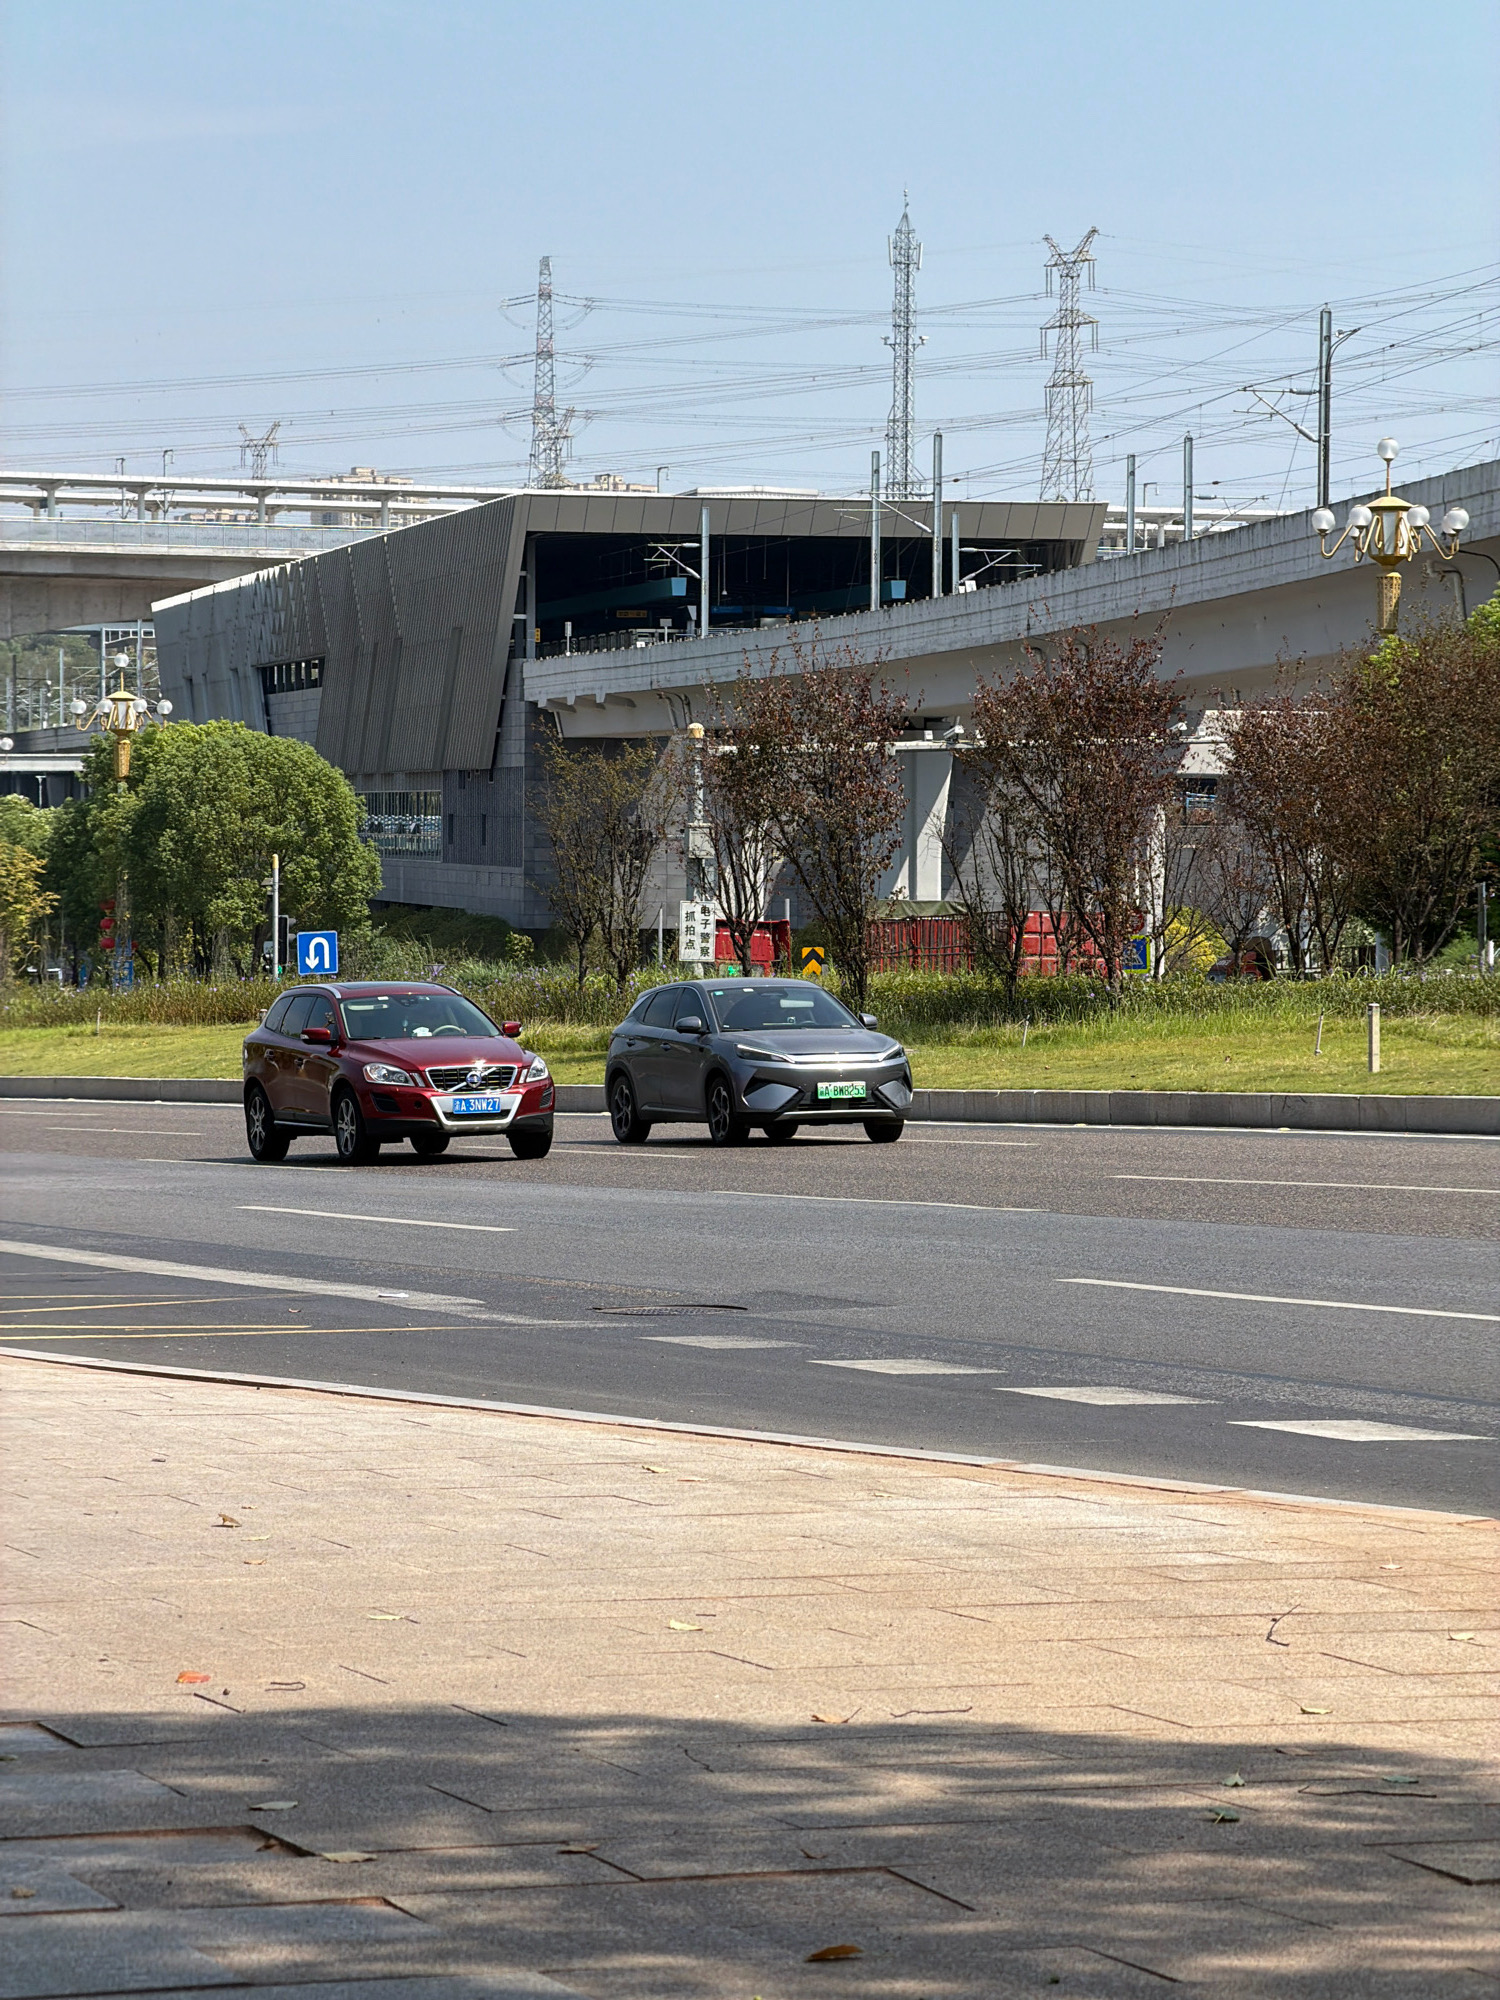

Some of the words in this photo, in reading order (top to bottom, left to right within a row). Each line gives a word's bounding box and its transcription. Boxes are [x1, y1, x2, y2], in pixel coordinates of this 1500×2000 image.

[684, 910, 696, 950] 抓拍点
[699, 904, 711, 957] 电子警察
